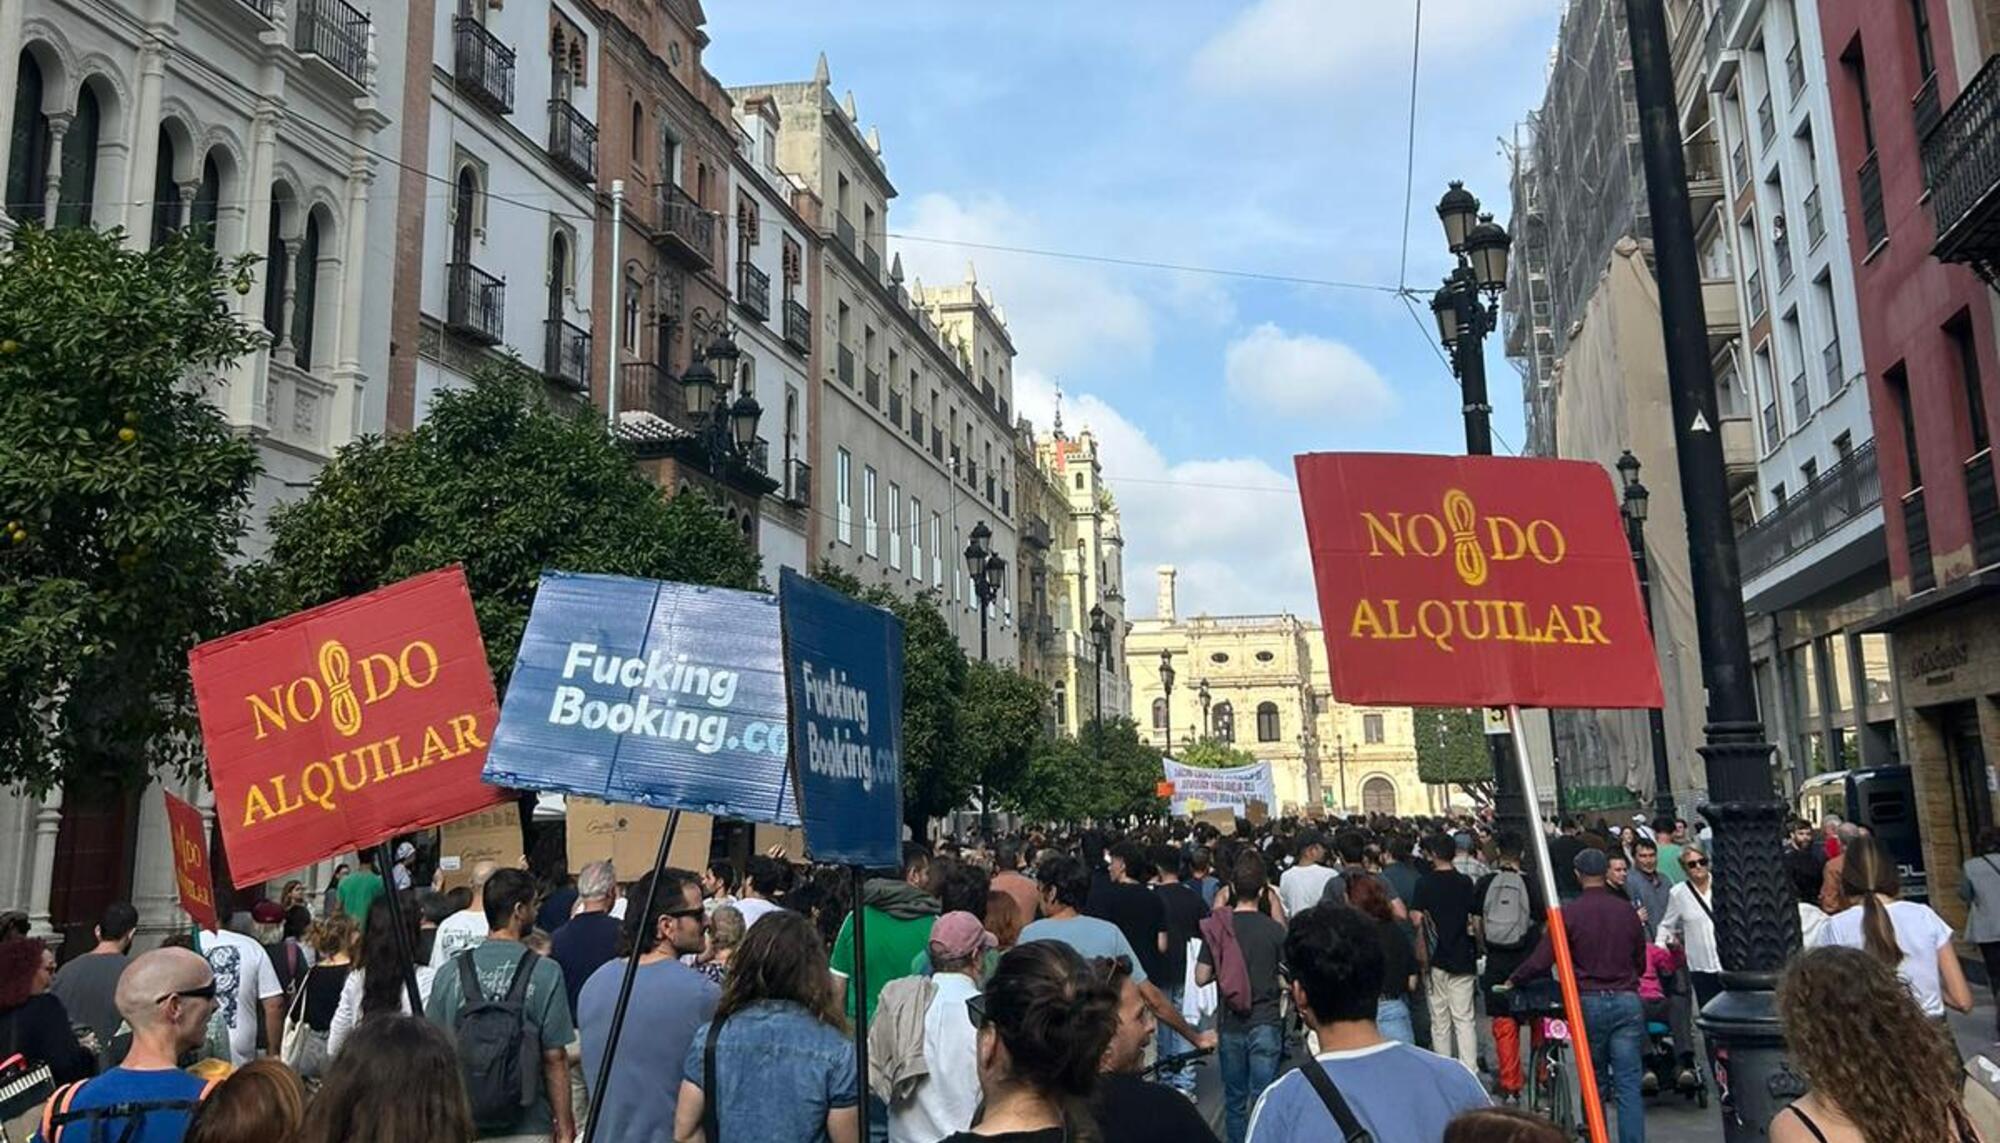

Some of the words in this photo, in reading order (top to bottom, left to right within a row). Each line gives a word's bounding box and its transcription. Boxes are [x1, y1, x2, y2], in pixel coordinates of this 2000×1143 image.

[1351, 599, 1611, 652] ALQUILAR
[562, 642, 738, 707] Fucking
[802, 660, 869, 735] Fucking
[243, 714, 487, 826] ALQUILAR
